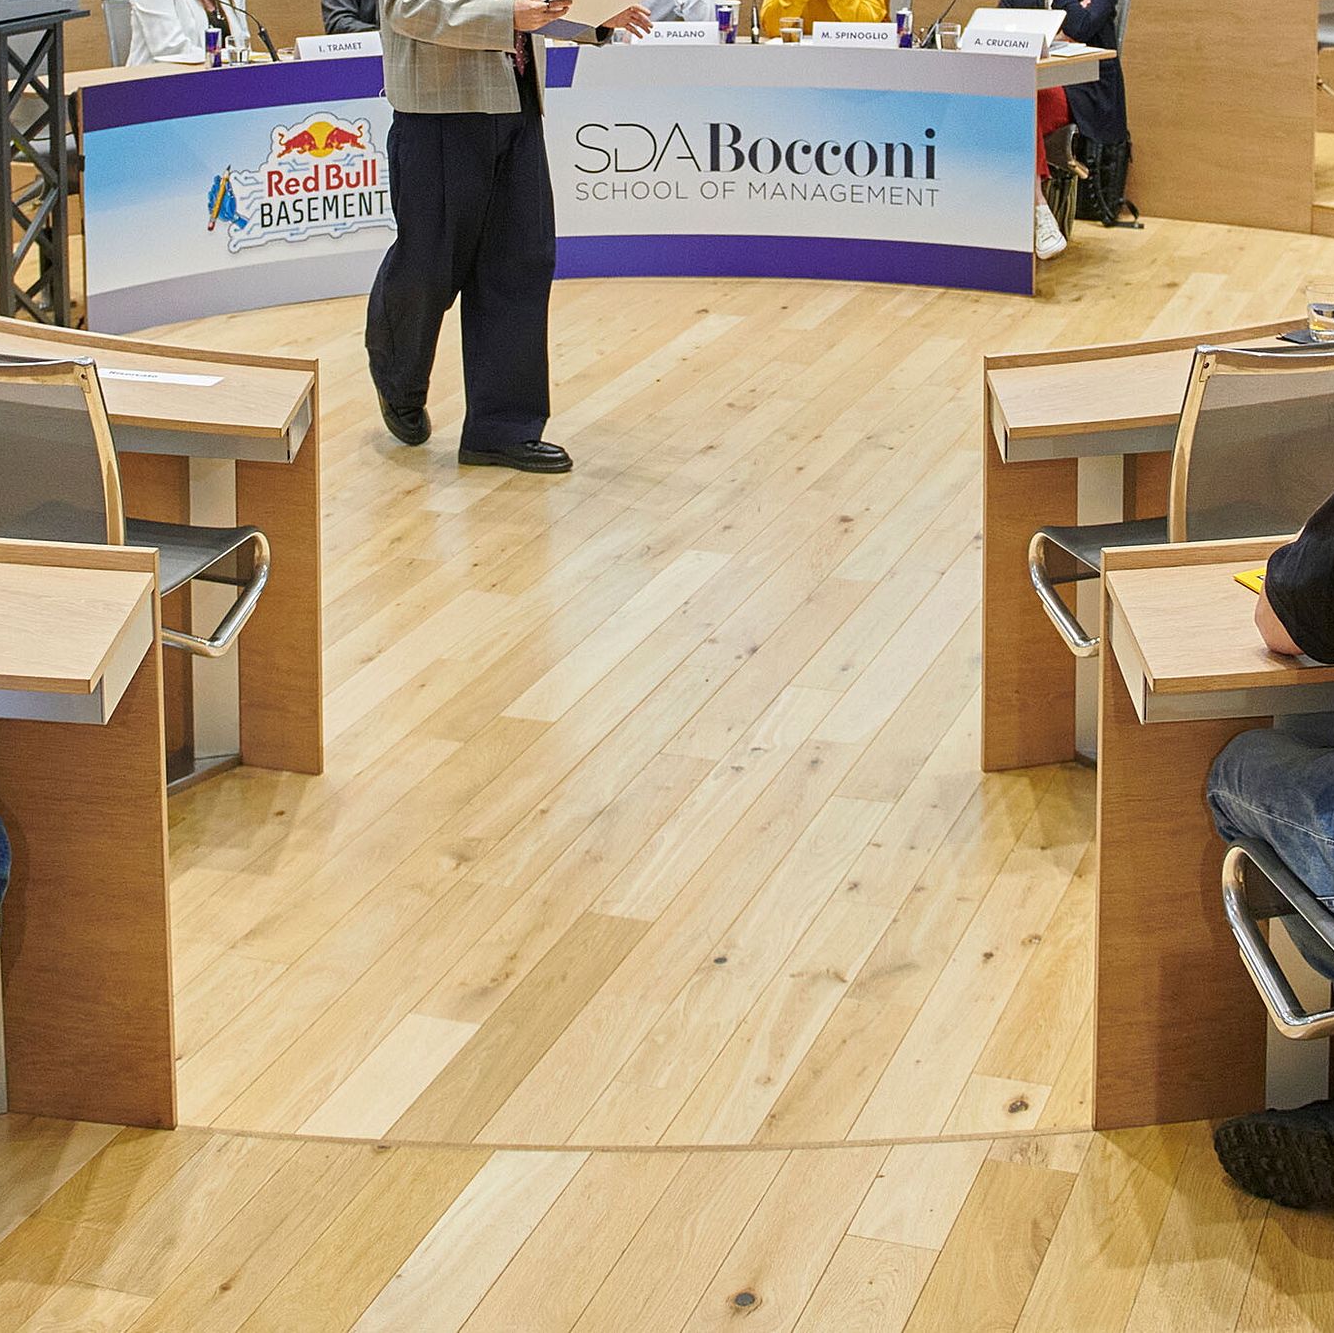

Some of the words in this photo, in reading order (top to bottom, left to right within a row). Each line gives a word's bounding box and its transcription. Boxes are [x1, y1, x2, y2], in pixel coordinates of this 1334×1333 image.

[654, 30, 663, 39] D.
[666, 30, 706, 39] PALANO
[821, 31, 833, 40] M.
[835, 31, 889, 41] SPINOGLIO
[327, 41, 363, 52] TRAMET
[974, 38, 983, 46] A.
[986, 39, 1029, 49] CRUCIANI
[267, 163, 320, 196] Red
[325, 159, 377, 191] Bull
[575, 180, 688, 201] SCHOOL
[701, 180, 736, 199] OF
[748, 181, 940, 208] MANAGEMENT
[260, 190, 388, 229] BASEMENT
